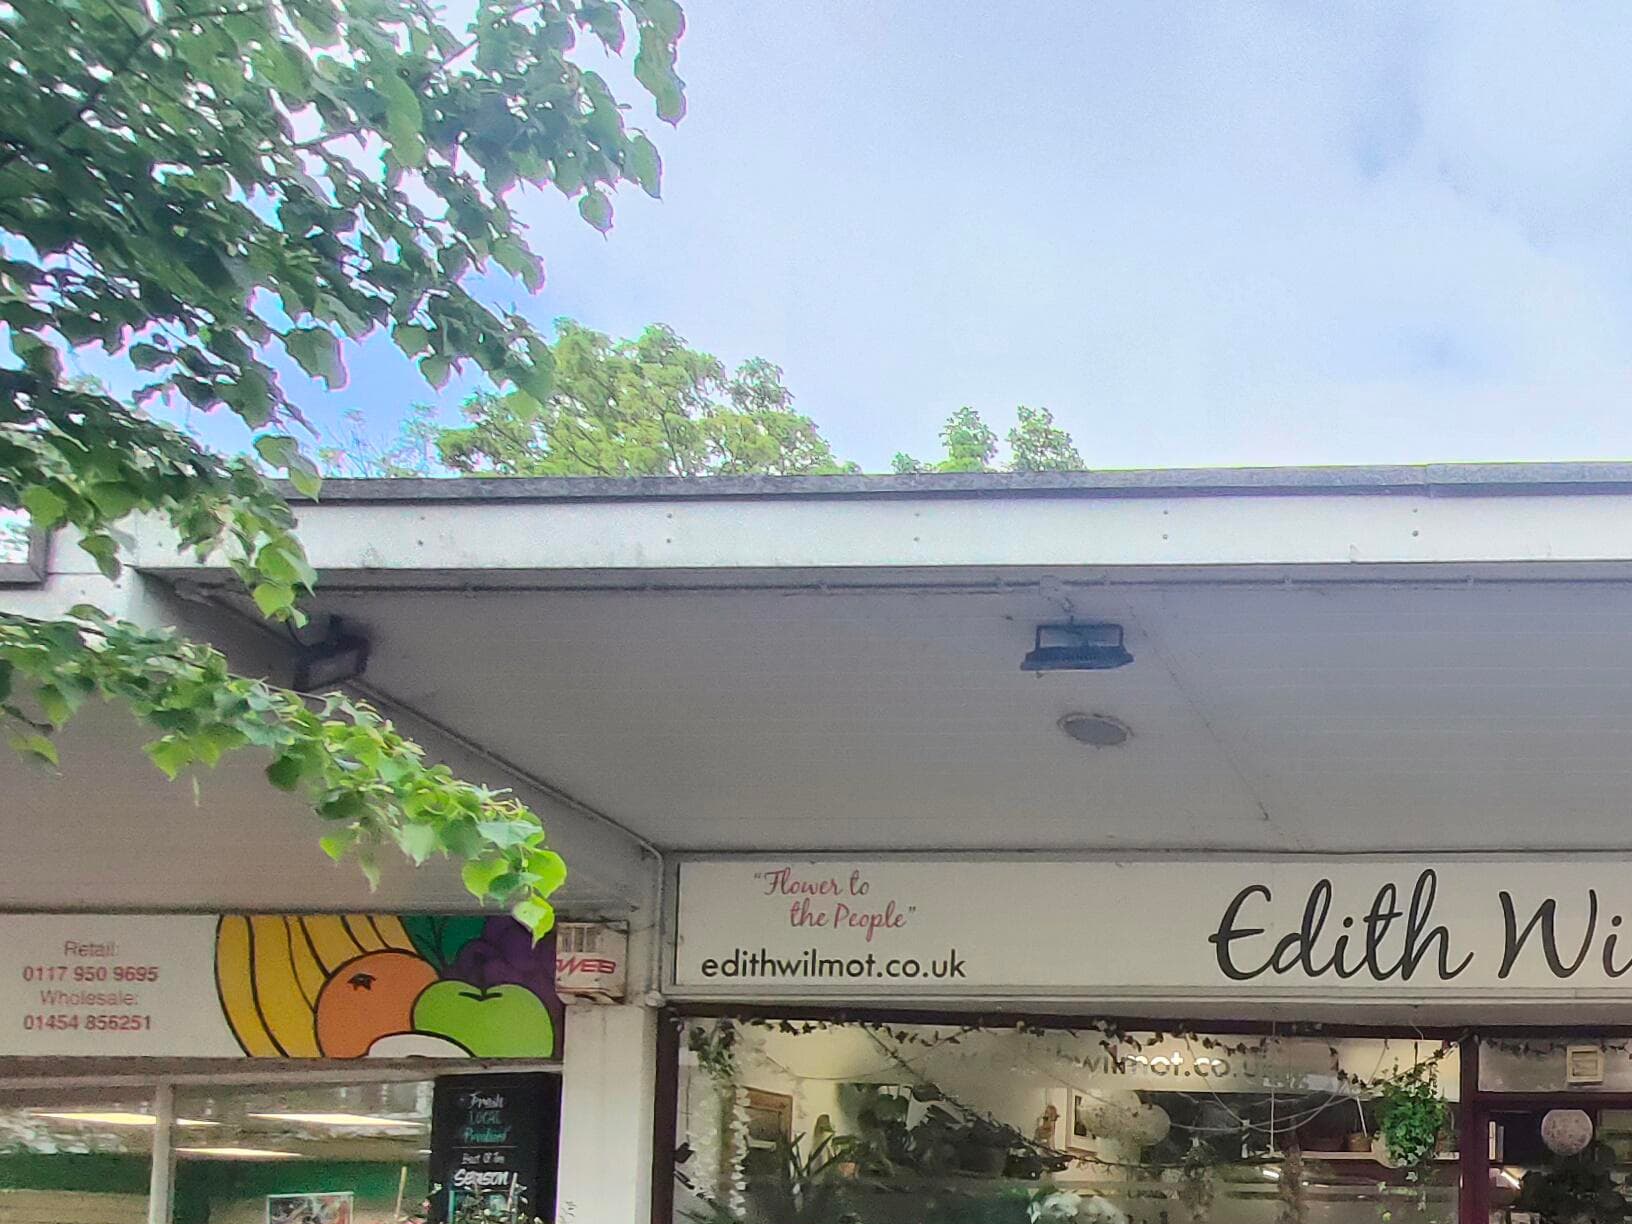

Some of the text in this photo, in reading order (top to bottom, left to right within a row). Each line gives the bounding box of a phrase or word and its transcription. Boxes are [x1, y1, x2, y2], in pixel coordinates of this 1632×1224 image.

[850, 869, 870, 896] to
[790, 897, 828, 927] the
[1208, 868, 1474, 981] Edith
[22, 965, 159, 982] 0117 950 9695
[701, 948, 967, 978] edithwilmot.co.uk
[40, 989, 138, 1006] Wholesale:
[23, 1014, 151, 1031] 01454 856251
